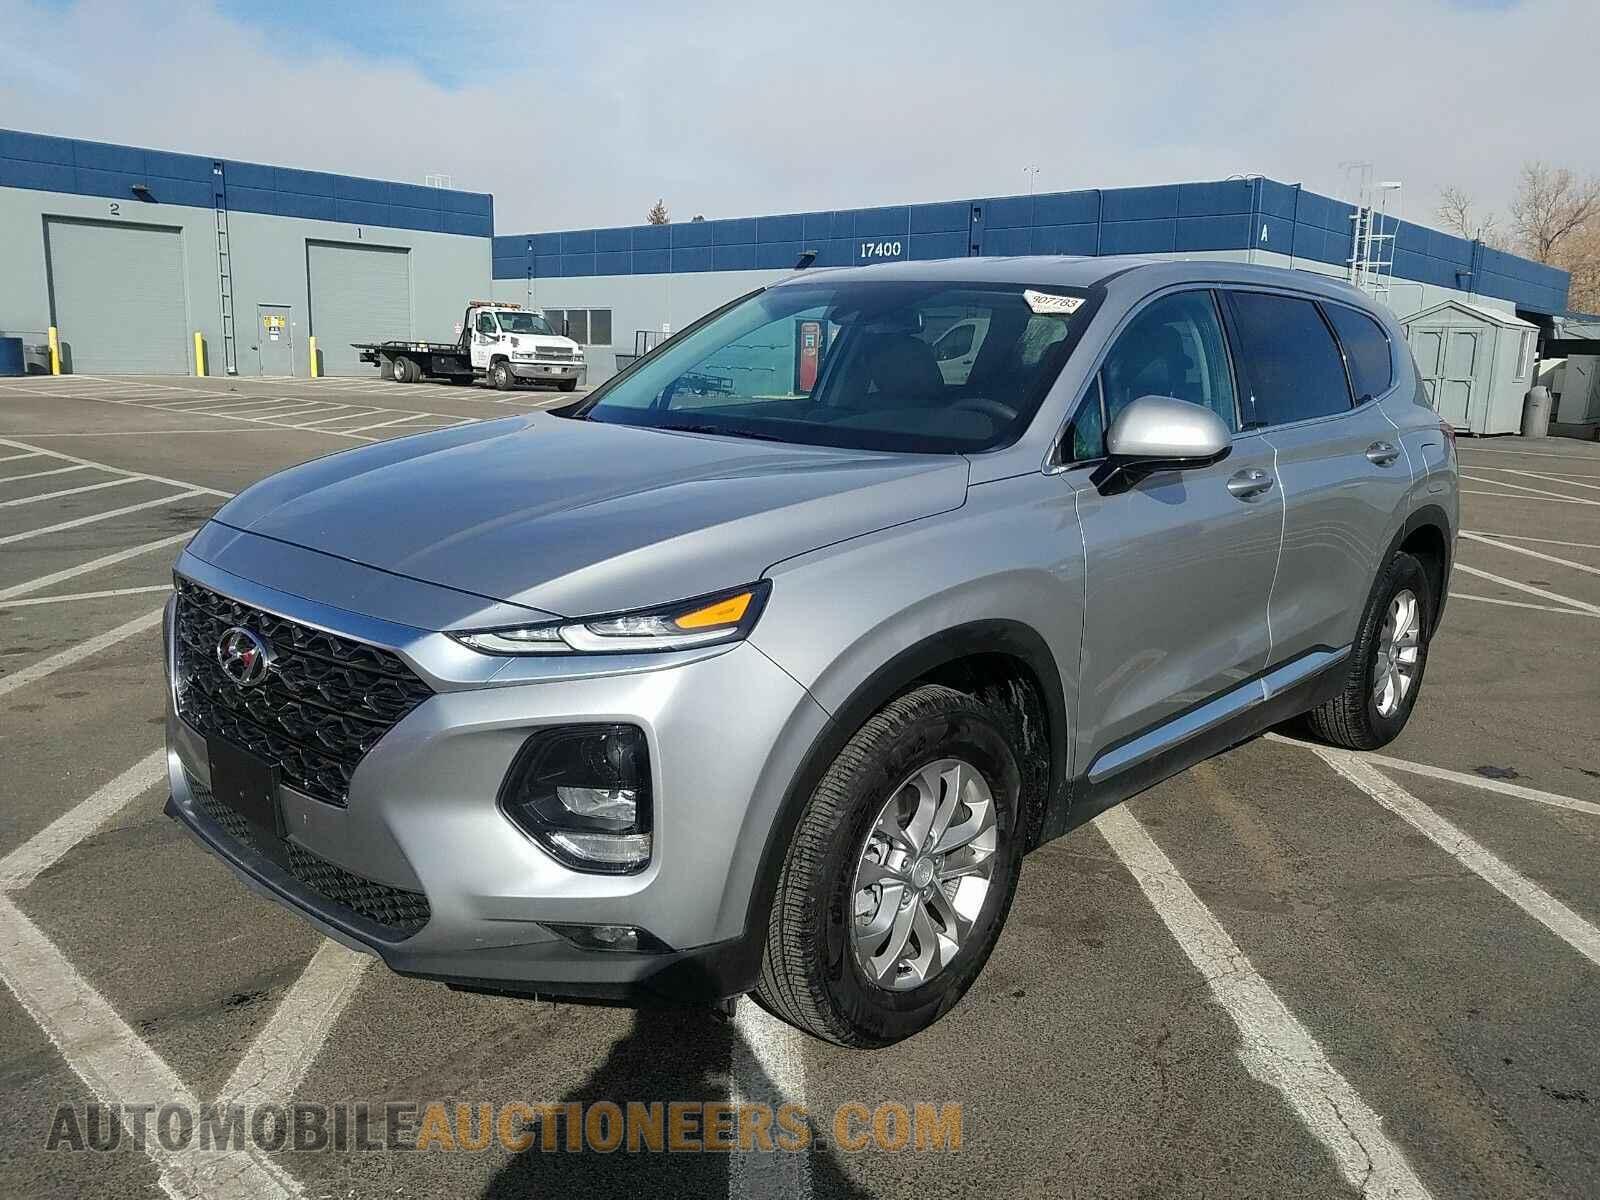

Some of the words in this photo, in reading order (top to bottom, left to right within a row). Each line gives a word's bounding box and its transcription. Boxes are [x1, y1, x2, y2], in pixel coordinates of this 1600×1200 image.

[109, 203, 120, 216] 2
[1260, 224, 1268, 241] A
[861, 241, 901, 258] 17400
